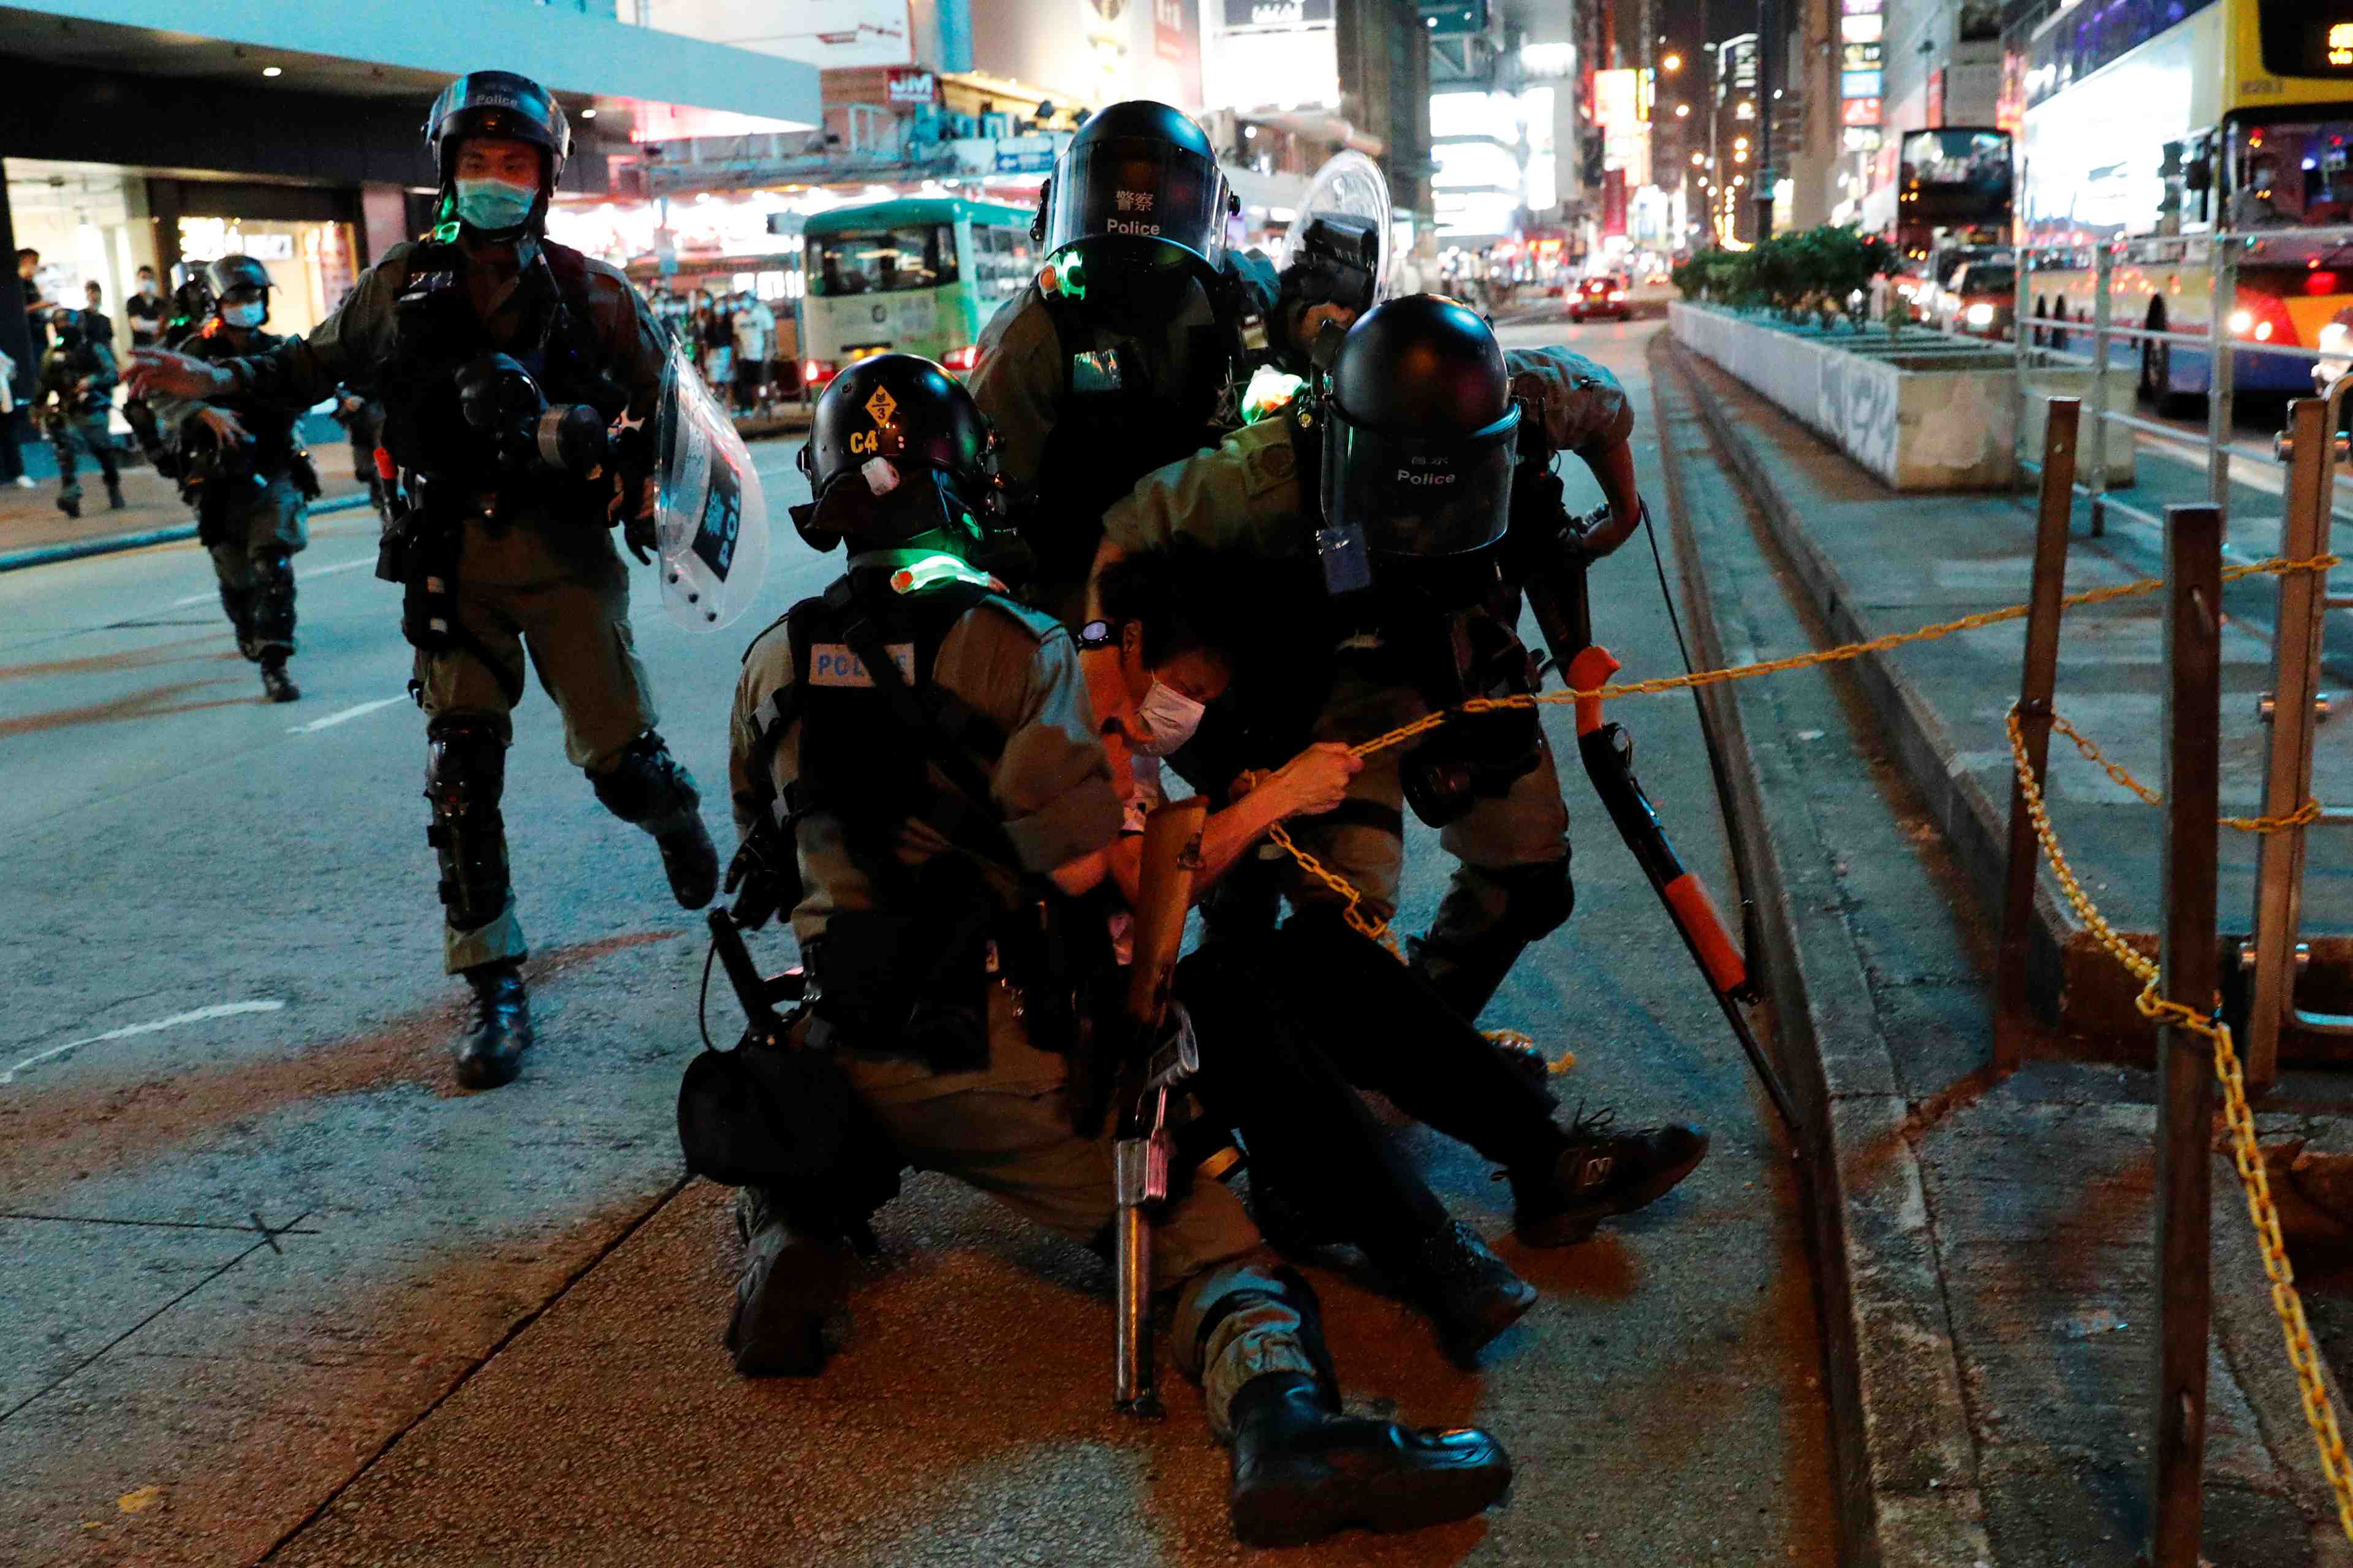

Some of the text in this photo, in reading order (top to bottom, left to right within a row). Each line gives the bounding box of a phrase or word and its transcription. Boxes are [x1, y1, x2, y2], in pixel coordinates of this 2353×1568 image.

[476, 93, 518, 106] Police
[1117, 191, 1153, 211] 警察
[1107, 218, 1160, 235] Police
[877, 407, 885, 419] 3
[851, 430, 878, 453] C4
[1397, 469, 1455, 485] Police
